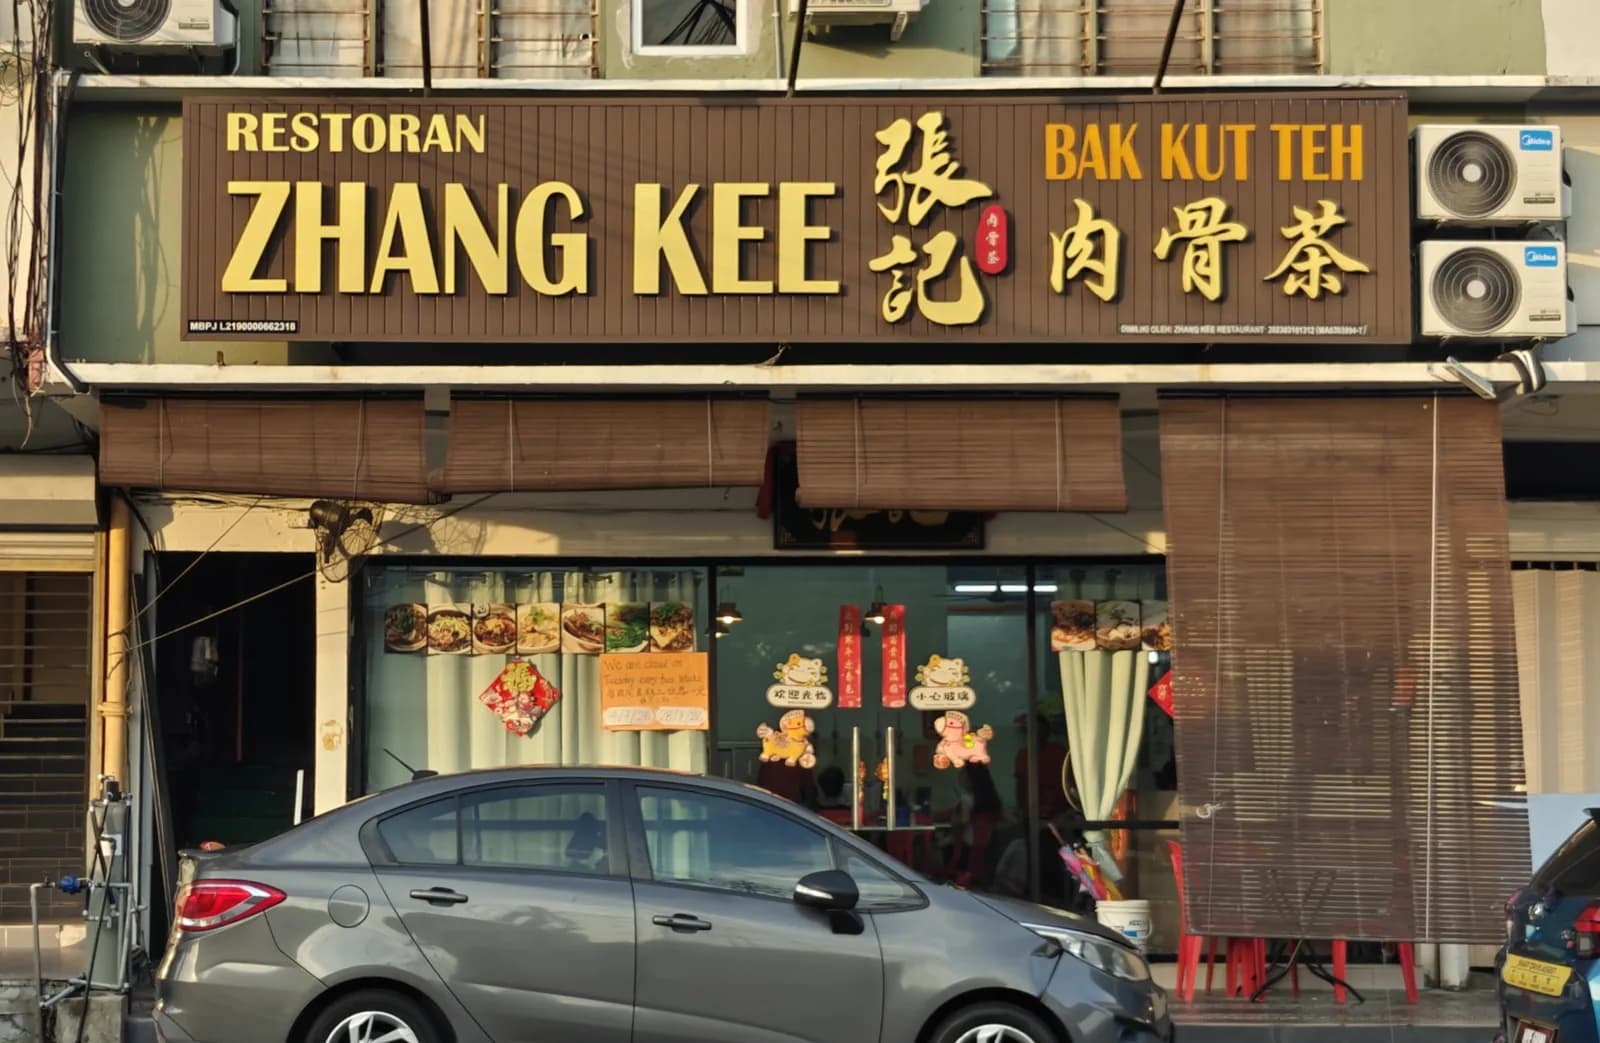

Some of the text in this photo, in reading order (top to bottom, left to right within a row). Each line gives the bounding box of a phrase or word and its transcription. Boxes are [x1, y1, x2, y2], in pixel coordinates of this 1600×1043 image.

[227, 112, 485, 153] RESTORAN
[1045, 123, 1363, 181] BAK KUT TEH
[221, 181, 840, 296] ZHANG KEE
[869, 111, 994, 325] 張記
[1049, 197, 1370, 301] 肉骨茶
[190, 322, 217, 331] MBPJ
[1174, 325, 1199, 334] ZHANG
[1200, 325, 1215, 334] KEE
[916, 691, 970, 701] 小心玻璃
